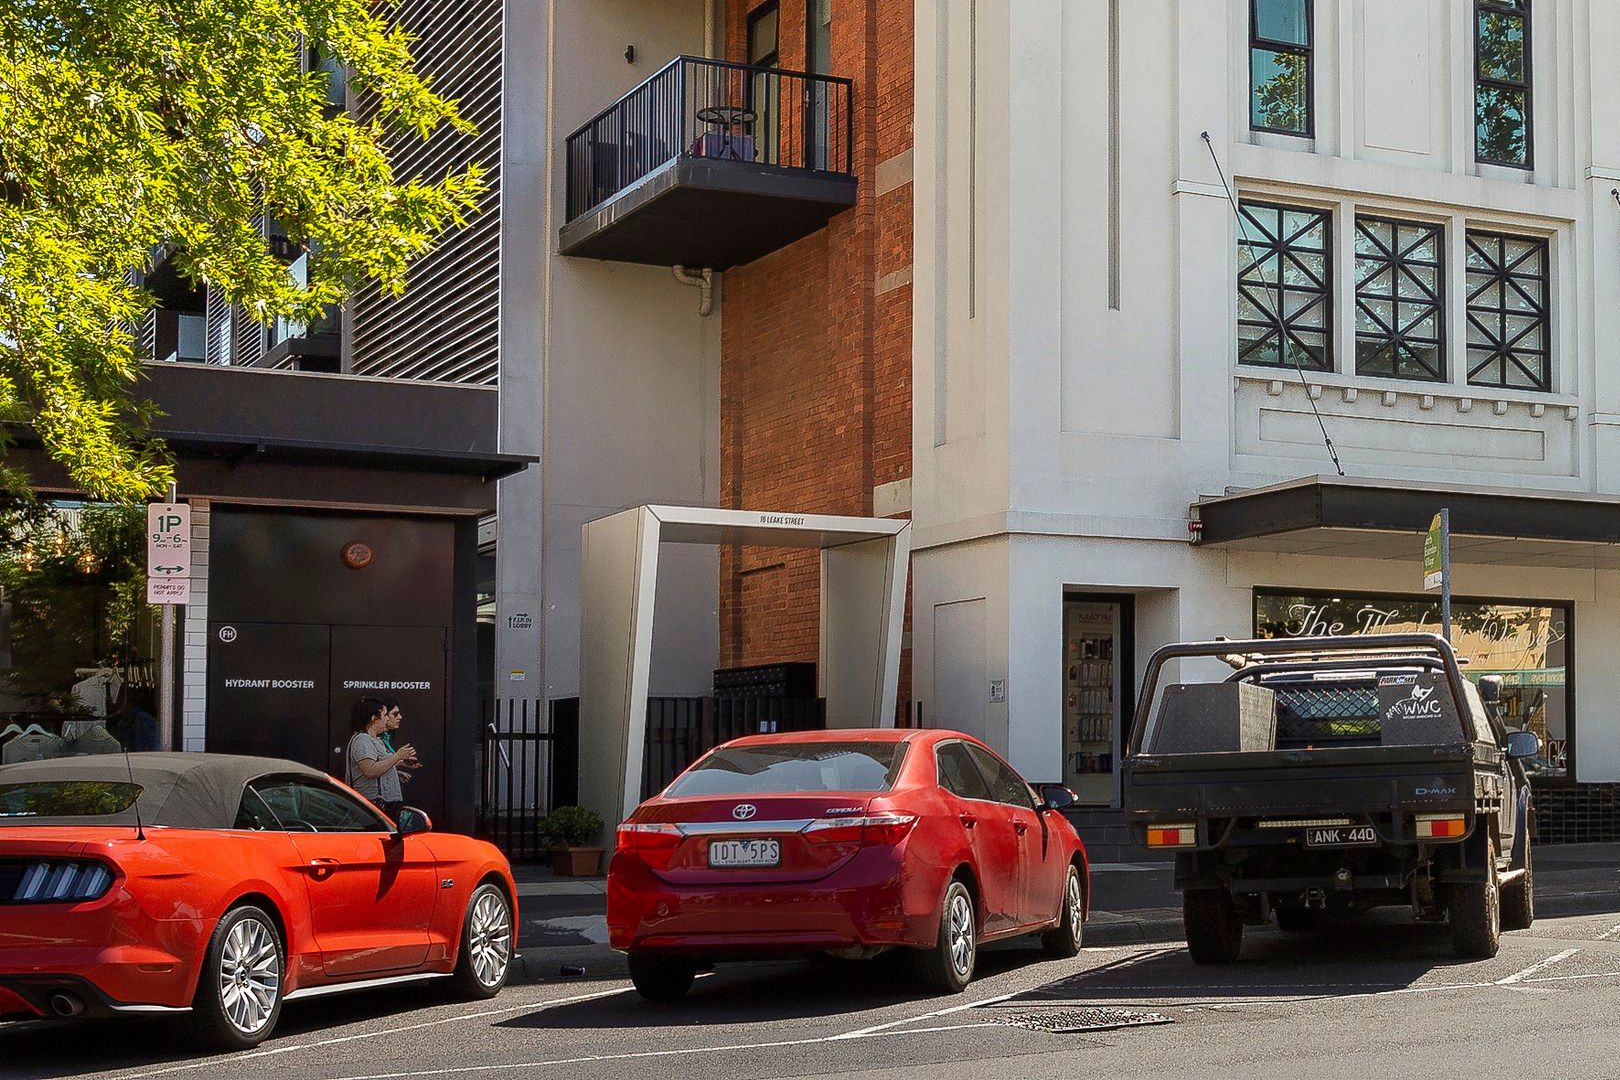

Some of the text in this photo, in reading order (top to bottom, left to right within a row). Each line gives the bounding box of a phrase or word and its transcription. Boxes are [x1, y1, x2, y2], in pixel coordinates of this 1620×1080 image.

[158, 515, 182, 532] 1P
[784, 517, 804, 525] STREET
[1285, 604, 1345, 636] The
[223, 630, 233, 638] FH
[225, 679, 314, 688] HYDRANT BOOSTER
[343, 680, 430, 689] SPRINKLER BOOSTER
[826, 806, 863, 814] COROLLA
[1315, 830, 1340, 843] ANK
[1349, 828, 1375, 841] 440
[714, 843, 778, 860] 1DT 5PS
